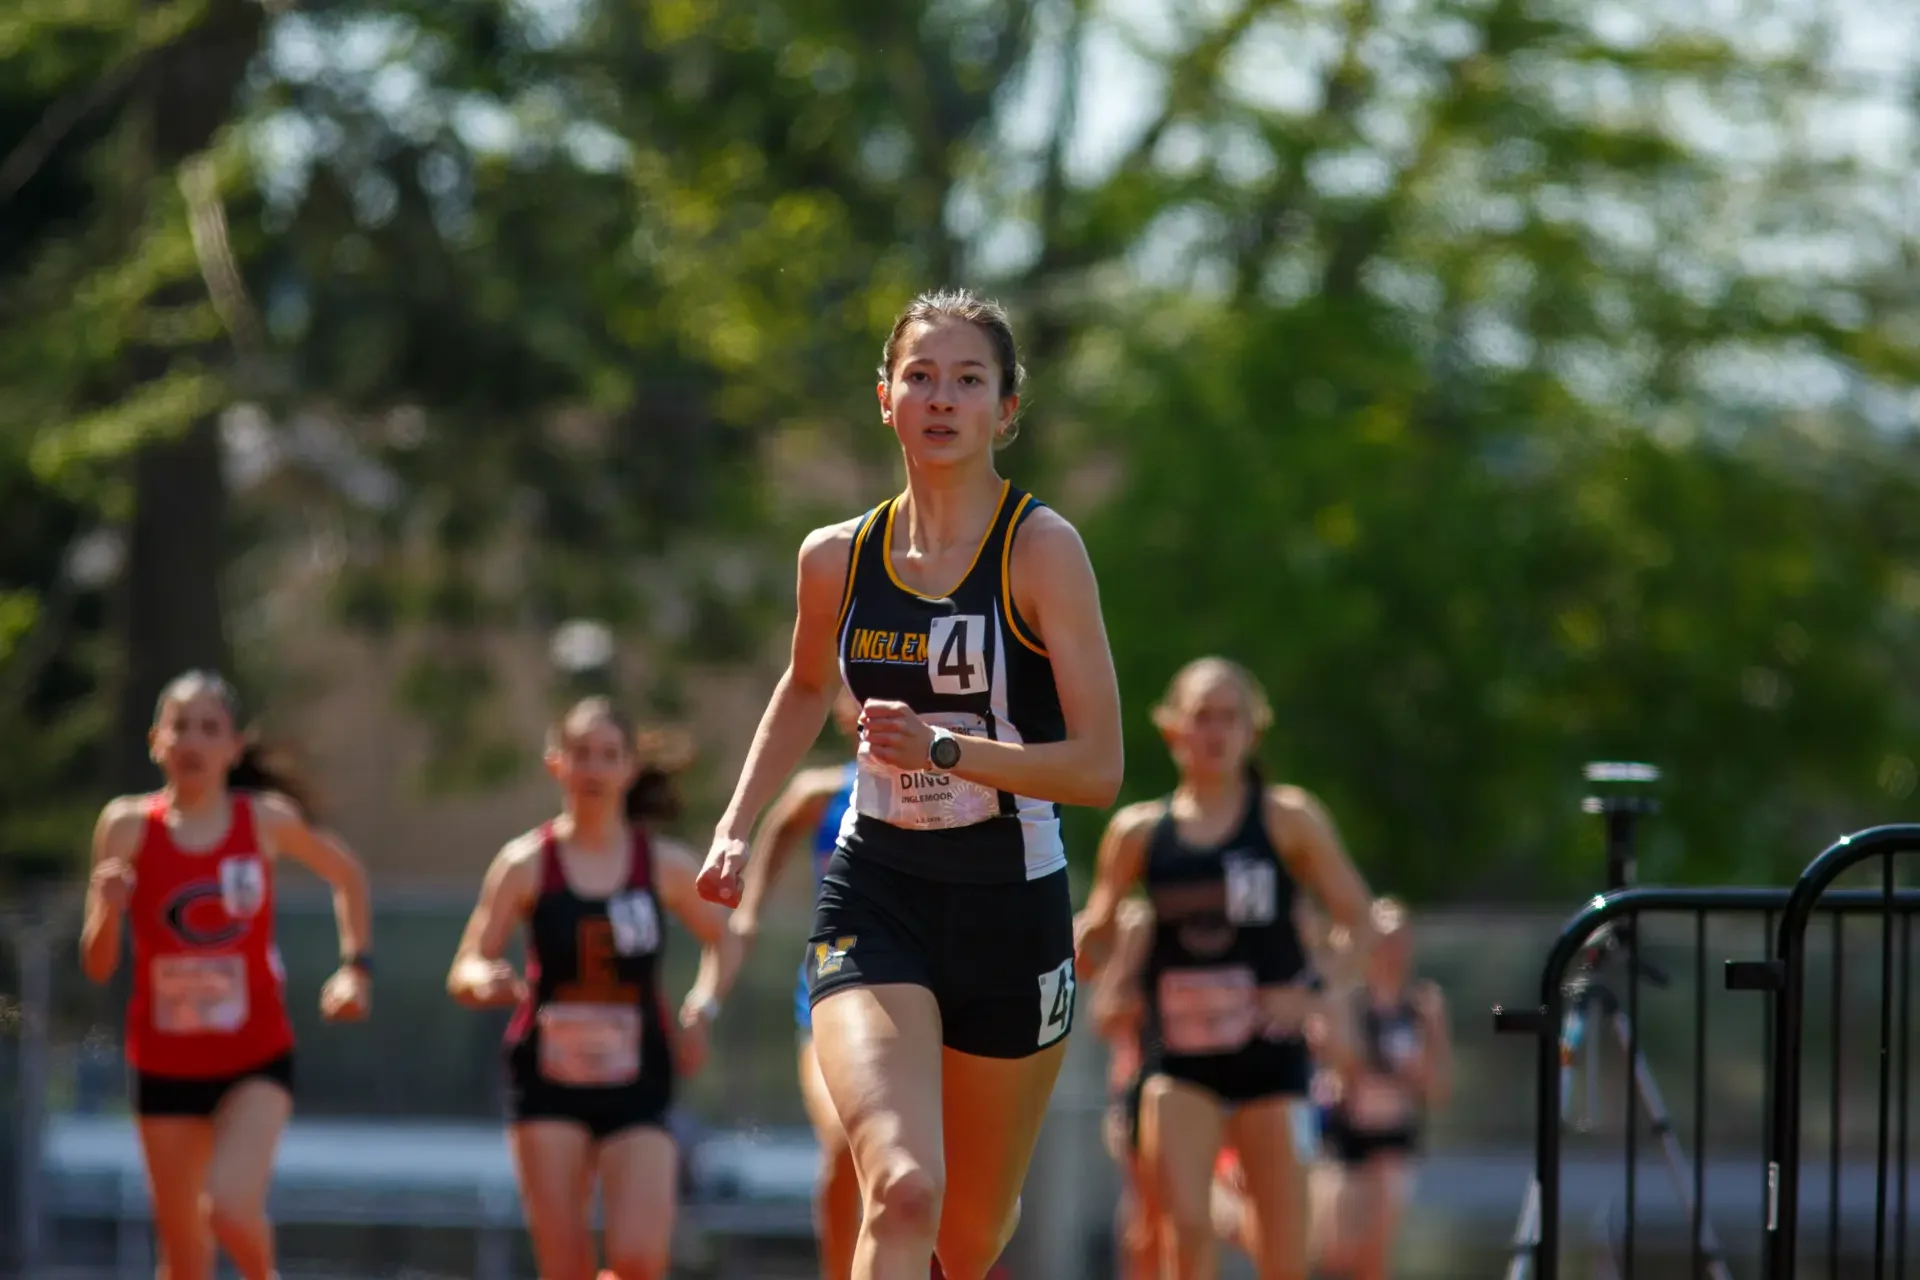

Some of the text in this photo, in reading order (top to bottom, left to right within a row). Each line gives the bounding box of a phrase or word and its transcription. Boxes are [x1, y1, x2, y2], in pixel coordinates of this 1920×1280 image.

[937, 620, 976, 690] 4
[900, 772, 950, 790] DING
[901, 792, 953, 804] INGLEMOOR
[1047, 966, 1069, 1031] 4
